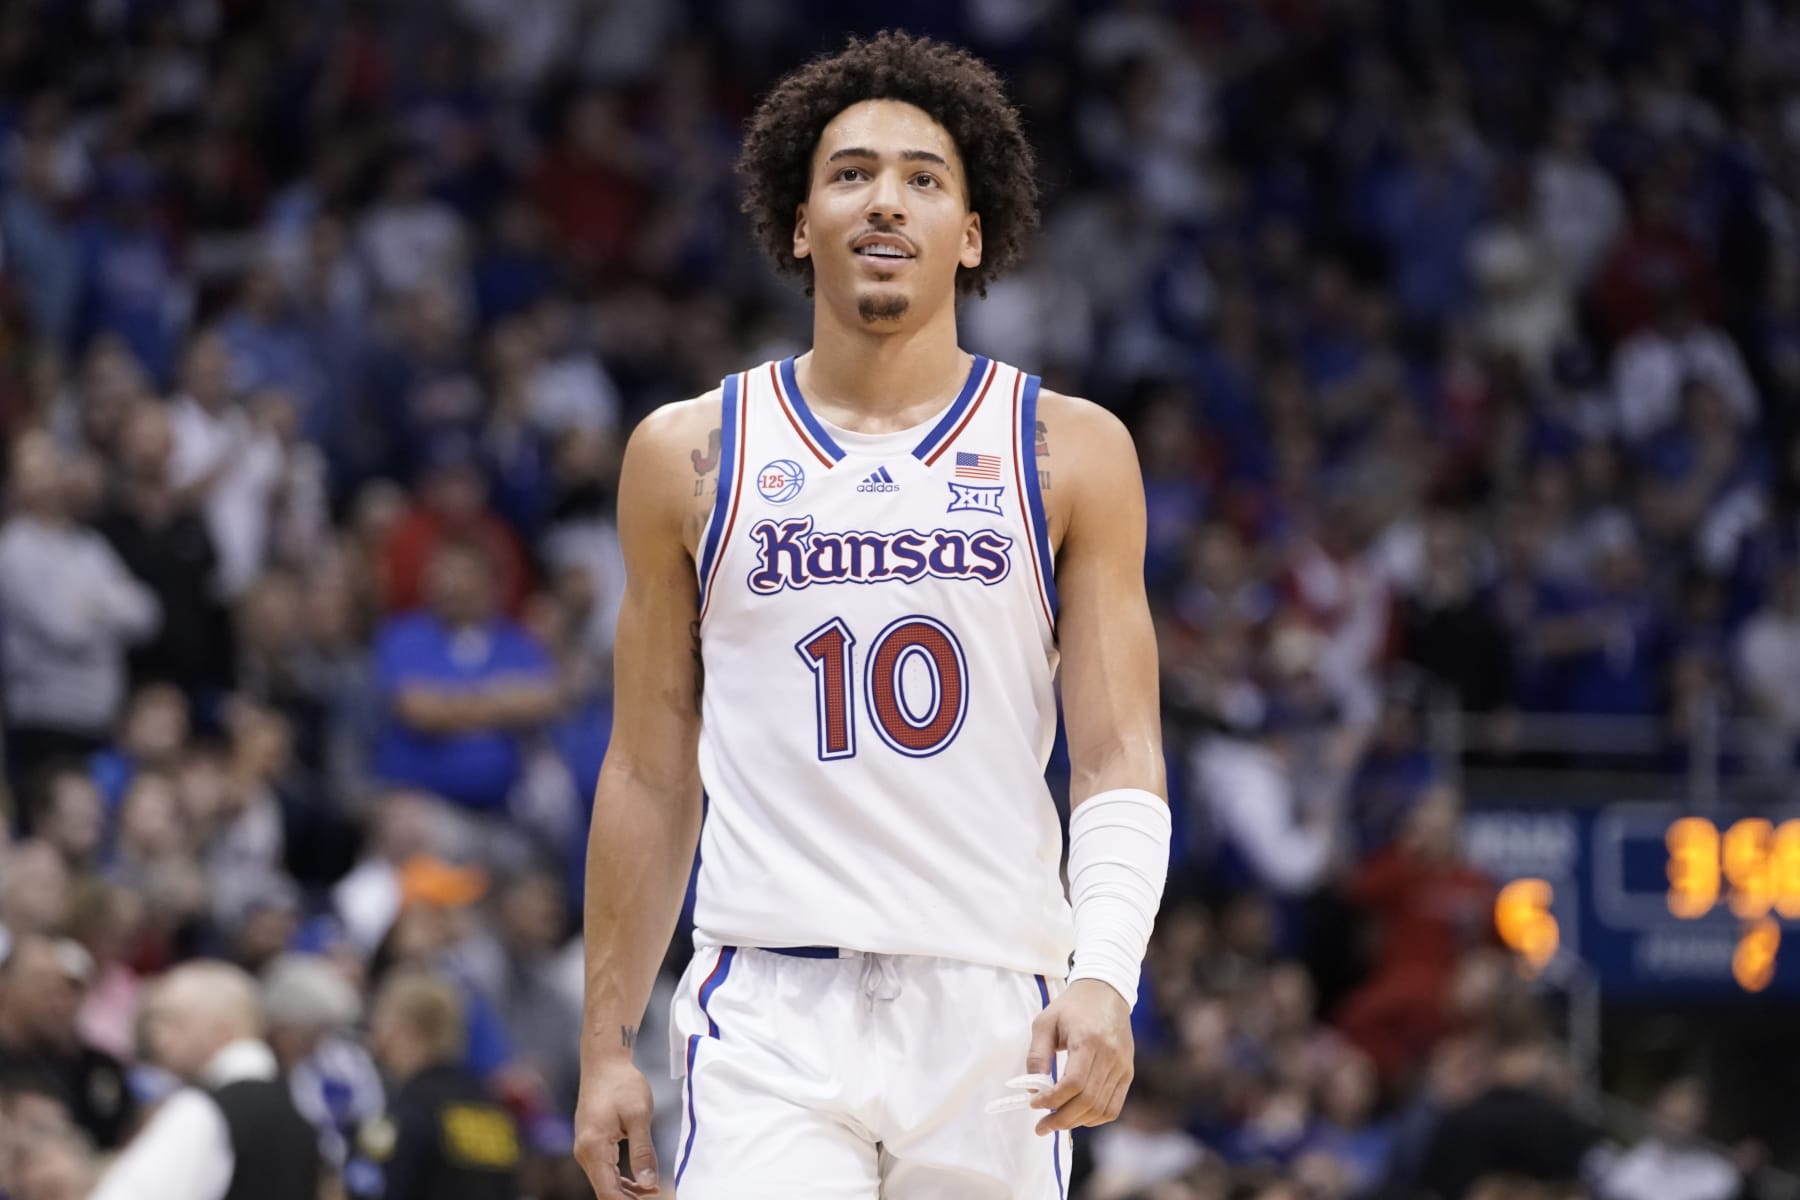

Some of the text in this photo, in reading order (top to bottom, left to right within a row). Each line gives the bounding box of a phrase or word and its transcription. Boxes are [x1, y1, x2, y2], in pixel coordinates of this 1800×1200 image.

[761, 474, 785, 489] 125
[856, 483, 900, 493] adidas
[747, 514, 1013, 596] Kansas
[795, 614, 969, 761] 10
